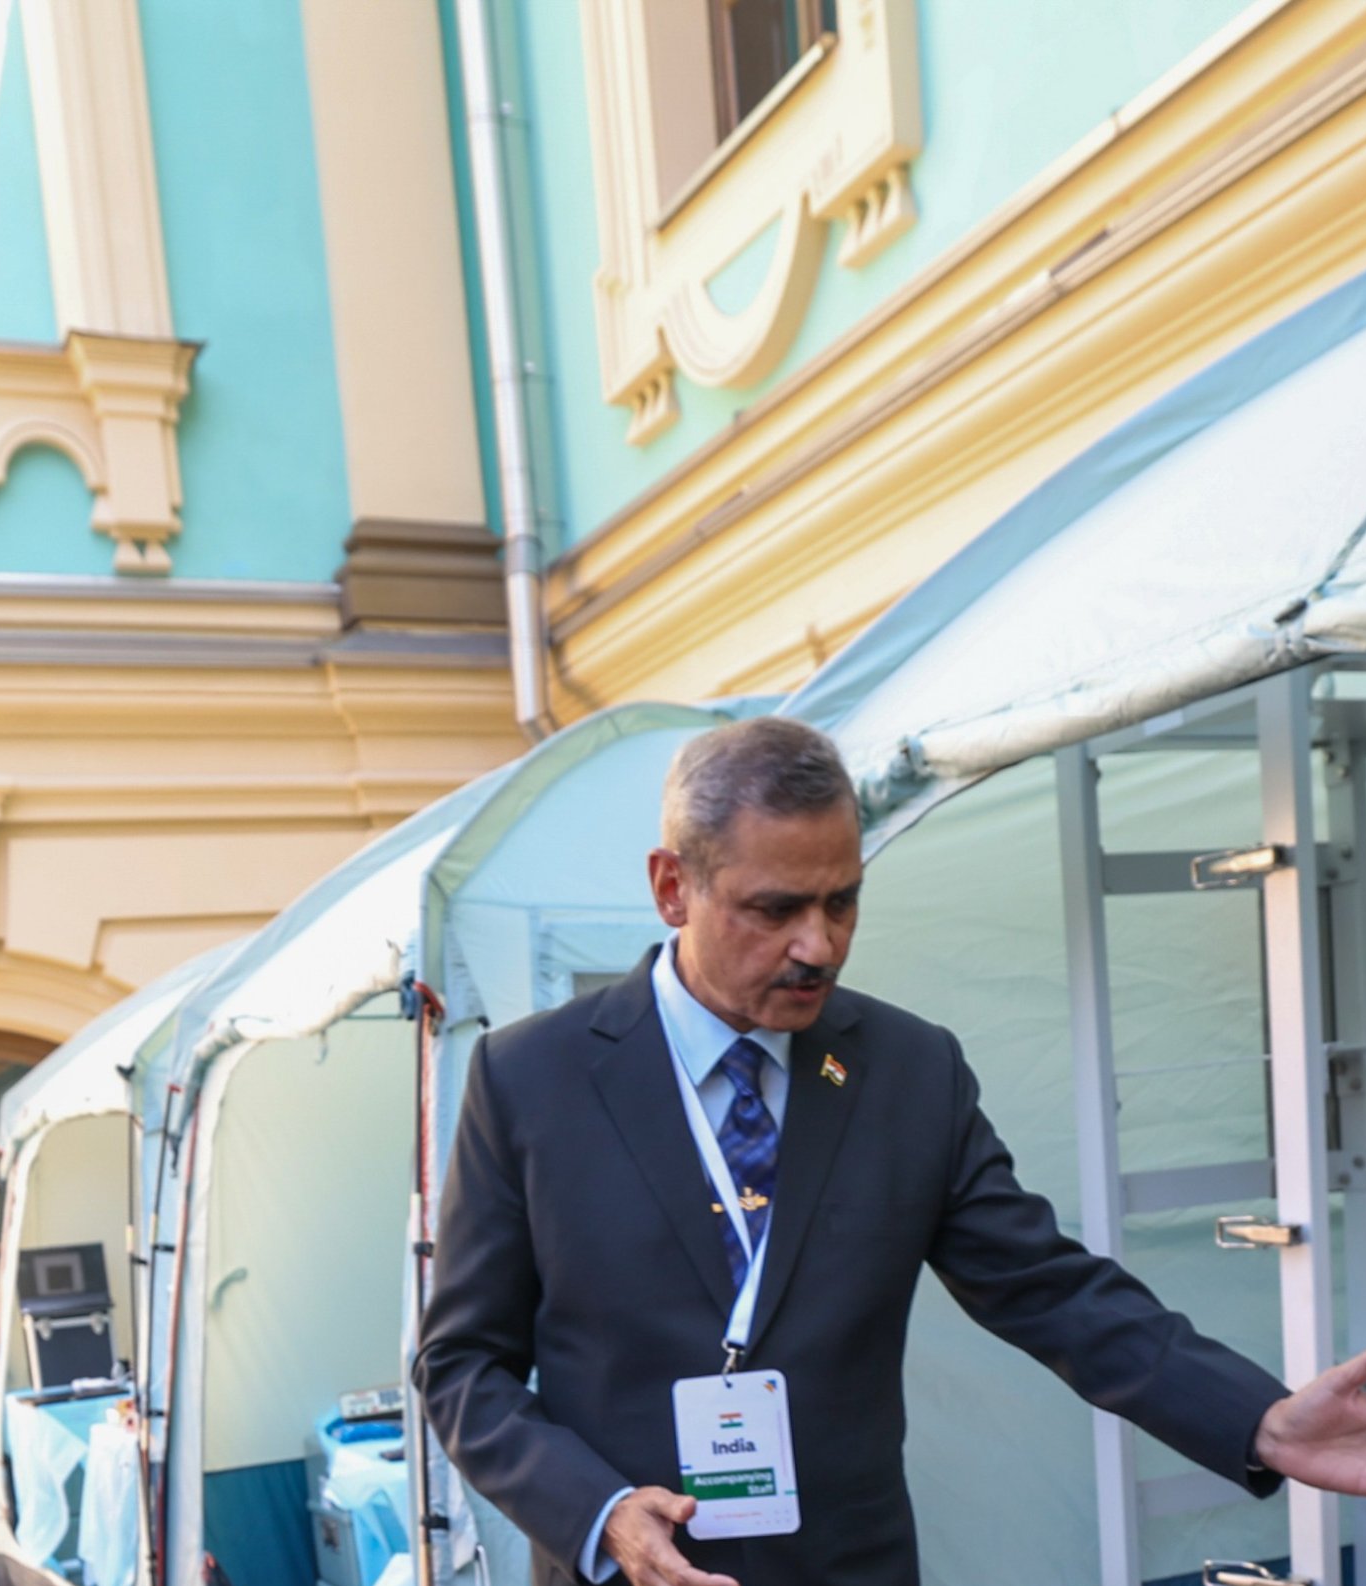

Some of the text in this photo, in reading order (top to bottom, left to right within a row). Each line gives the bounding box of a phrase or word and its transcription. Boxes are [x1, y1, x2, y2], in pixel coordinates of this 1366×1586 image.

[712, 1438, 756, 1455] India
[693, 1471, 772, 1486] Accompanying
[748, 1483, 773, 1495] Staff
